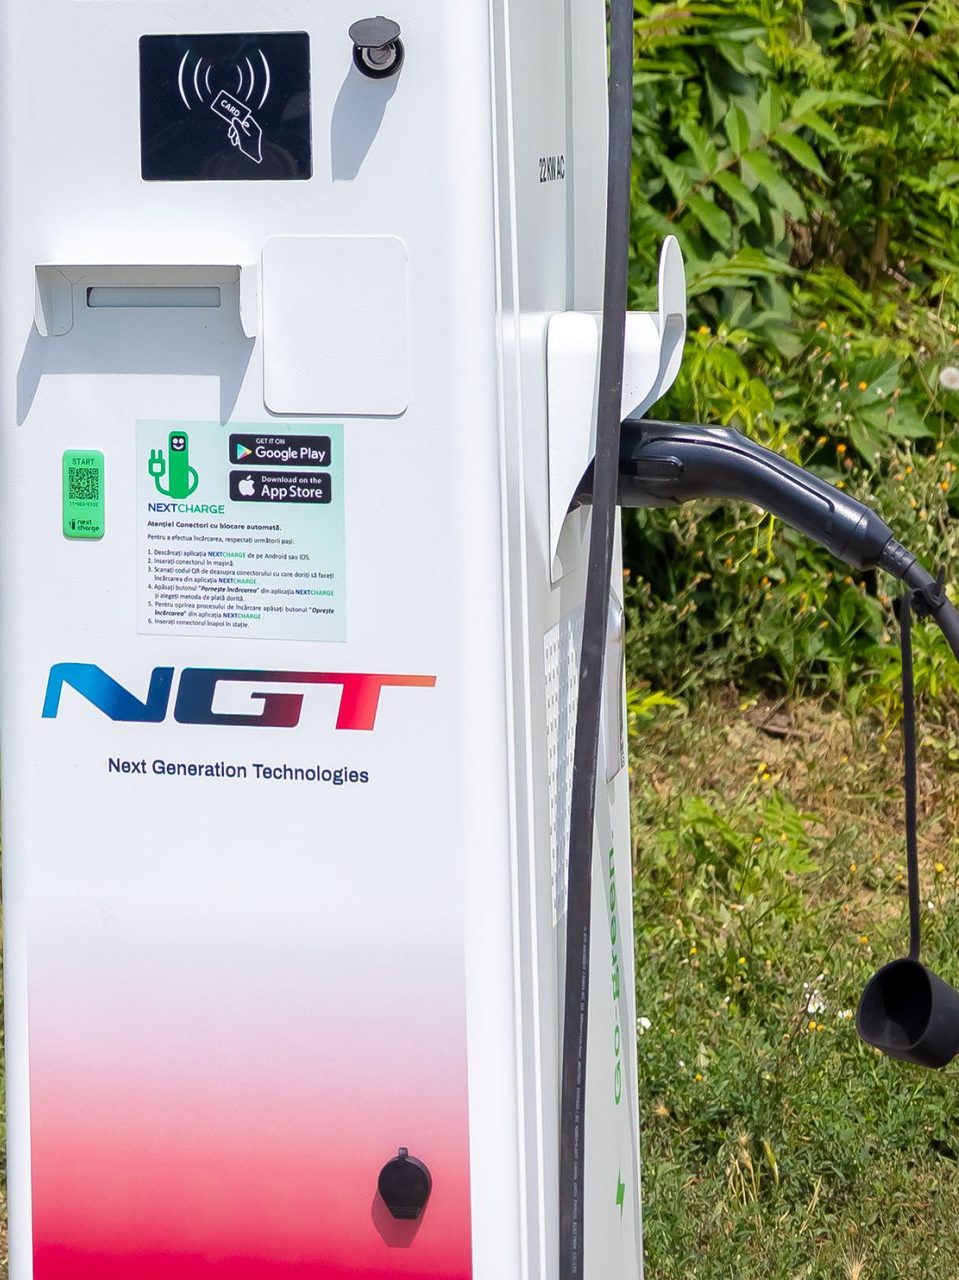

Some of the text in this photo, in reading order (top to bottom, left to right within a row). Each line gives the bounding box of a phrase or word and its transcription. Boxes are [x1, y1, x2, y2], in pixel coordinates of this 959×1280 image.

[220, 99, 241, 117] CARD
[539, 157, 546, 183] 22
[557, 155, 564, 180] AC
[255, 446, 326, 463] Google Play
[261, 476, 297, 484] Download
[261, 485, 323, 500] App Store
[147, 503, 225, 514] NEXTCHARGE
[77, 525, 100, 533] charge
[42, 662, 437, 731] NGT
[108, 757, 369, 785] Next Generation Technologies
